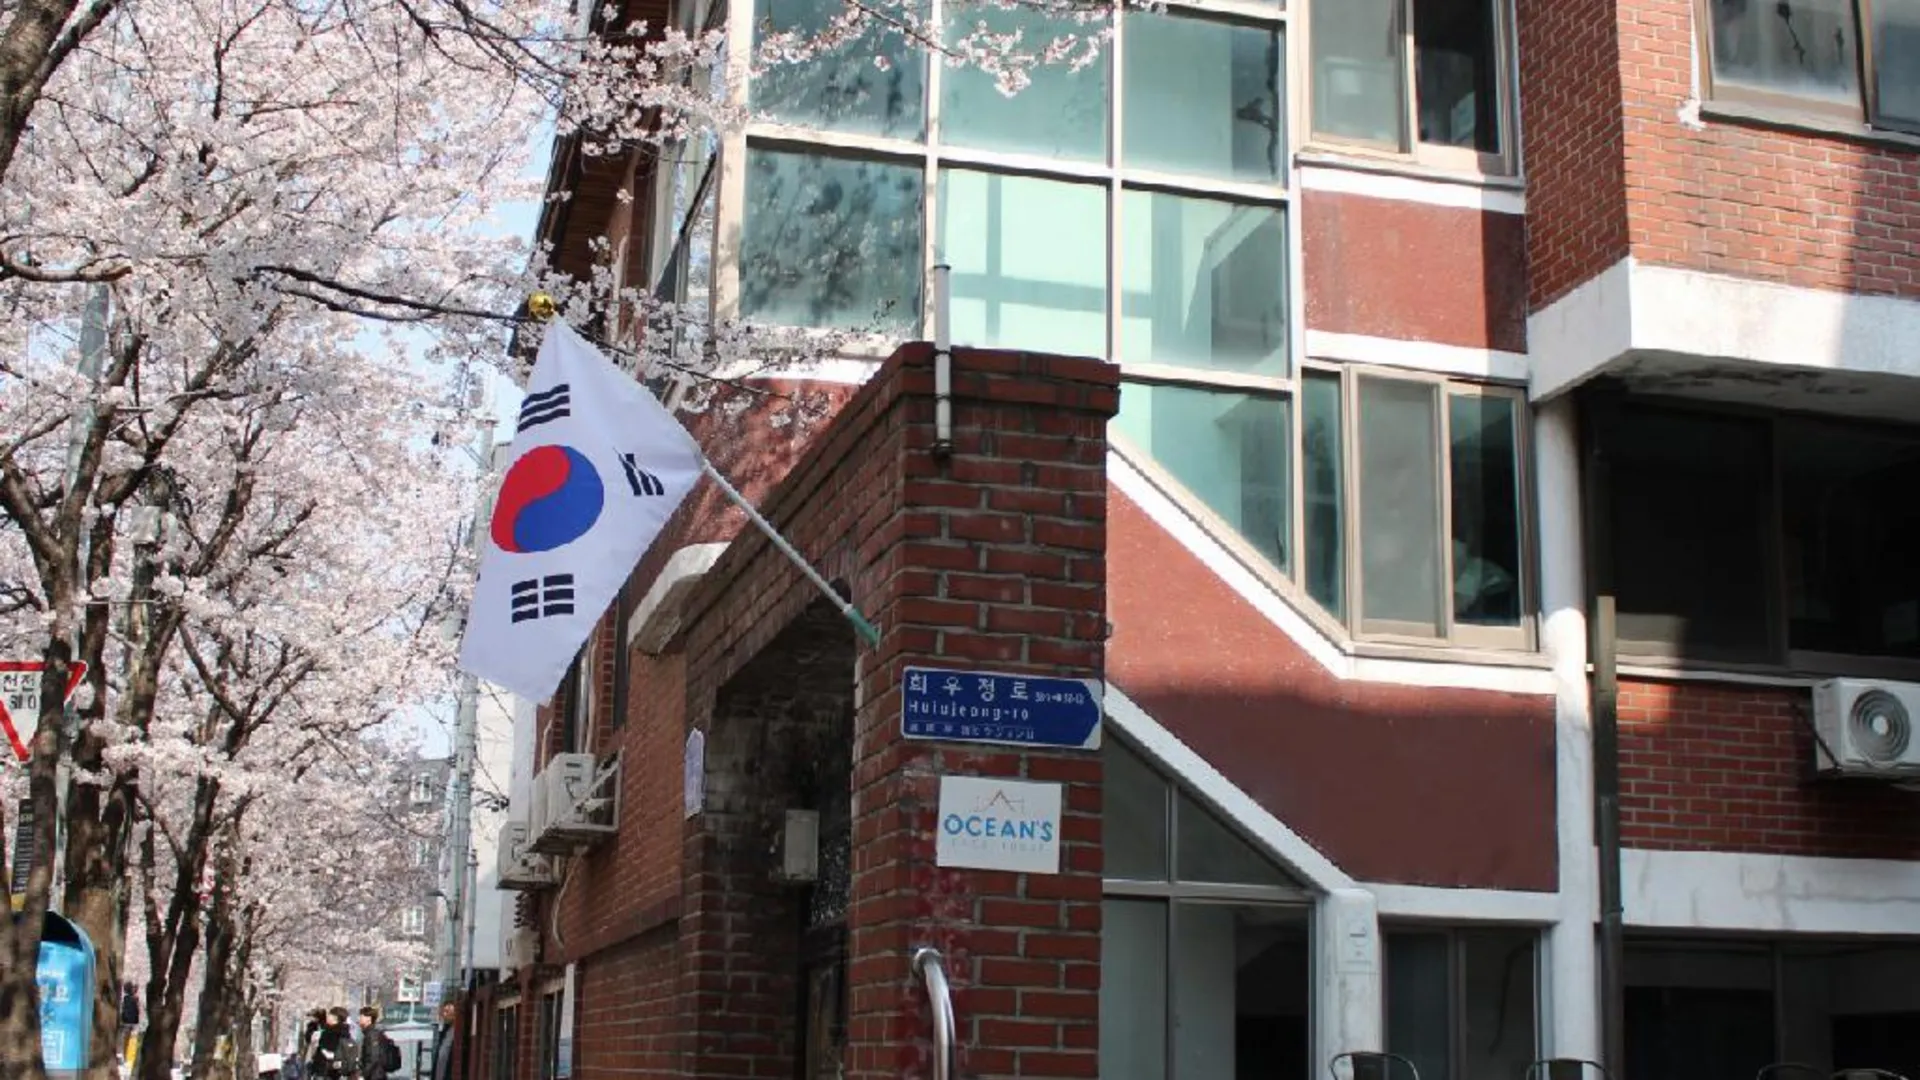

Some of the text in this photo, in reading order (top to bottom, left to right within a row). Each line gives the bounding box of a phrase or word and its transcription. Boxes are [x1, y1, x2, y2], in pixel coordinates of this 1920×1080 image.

[3, 674, 36, 693] 천천
[909, 674, 1029, 701] 희우정로
[909, 700, 1029, 721] Huiujeong-ro
[944, 813, 1053, 842] OCEAN'S
